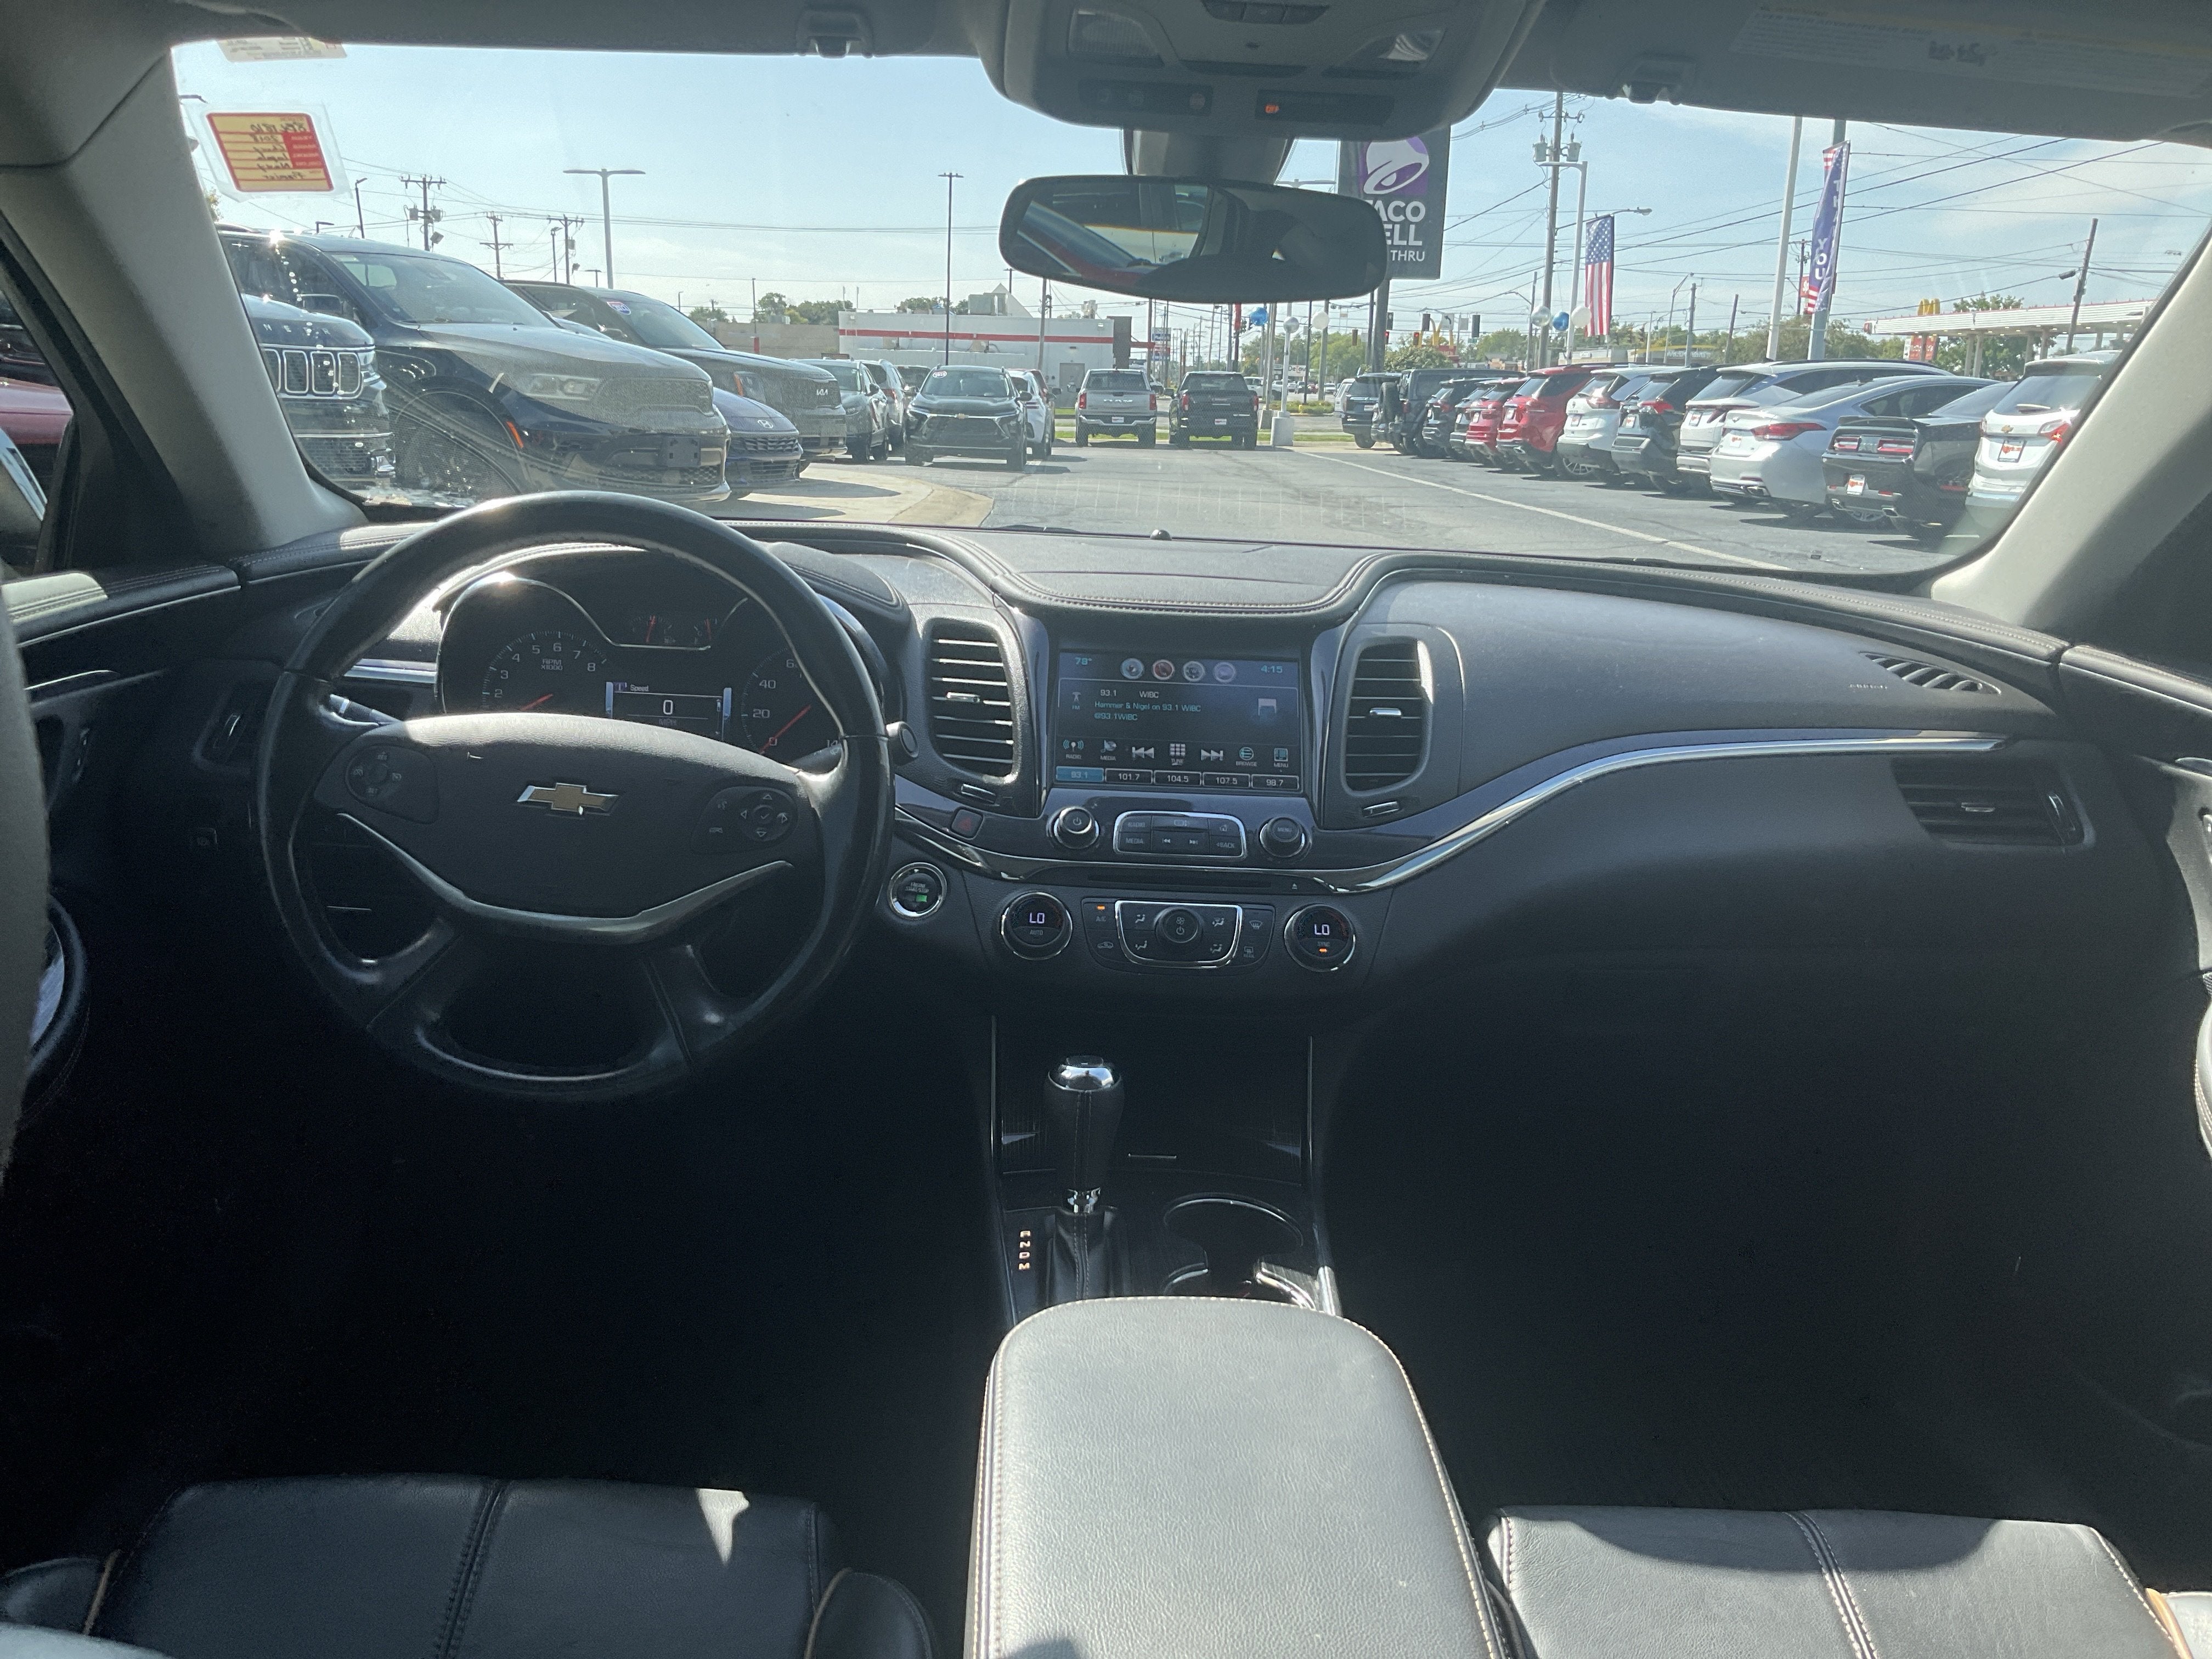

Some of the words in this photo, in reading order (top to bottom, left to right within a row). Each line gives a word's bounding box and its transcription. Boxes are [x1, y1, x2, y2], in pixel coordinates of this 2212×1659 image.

[1364, 200, 1426, 222] ACO
[1383, 224, 1422, 246] ELL
[1390, 250, 1426, 262] THRU
[532, 645, 540, 654] 5
[553, 642, 562, 652] 6
[512, 653, 520, 662] 4
[573, 650, 580, 659] 7
[587, 662, 596, 672] 8
[786, 659, 797, 668] 6
[500, 670, 509, 679] 3
[759, 680, 776, 689] 40
[494, 689, 503, 698] 2
[663, 699, 673, 715] 0
[753, 709, 770, 718] 20
[1029, 912, 1045, 924] LO
[1314, 924, 1330, 935] LO
[1019, 1251, 1030, 1260] D
